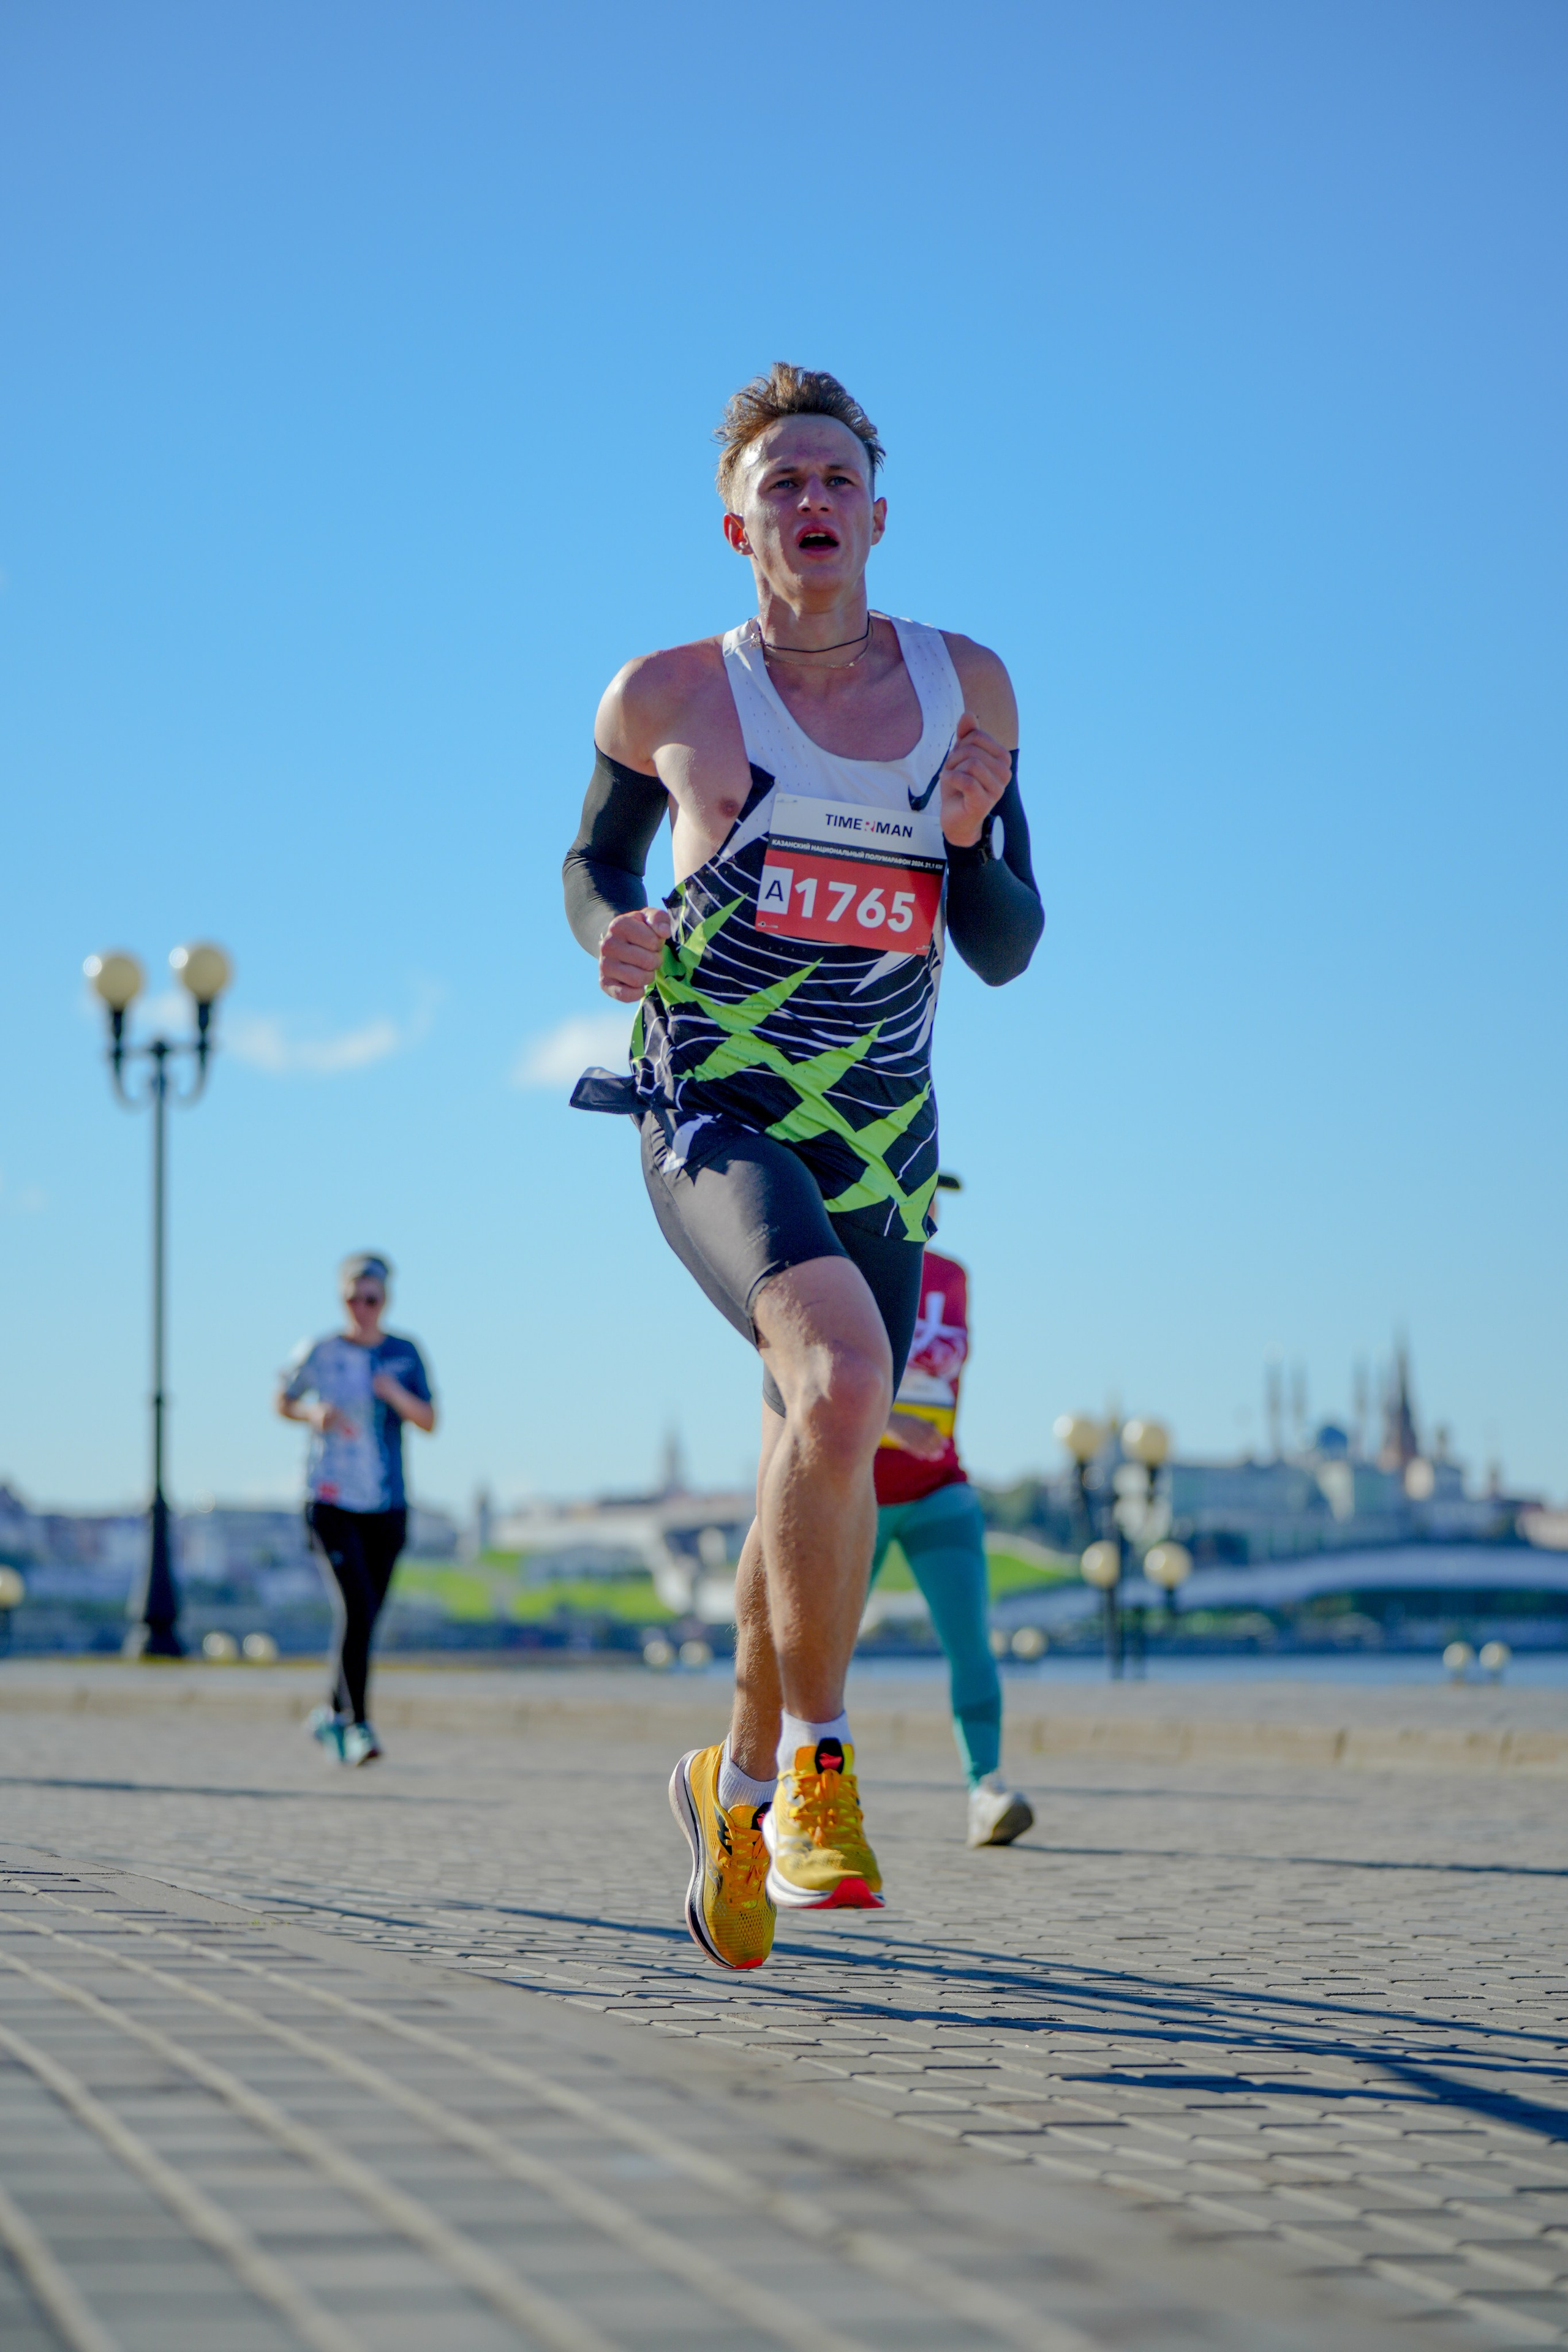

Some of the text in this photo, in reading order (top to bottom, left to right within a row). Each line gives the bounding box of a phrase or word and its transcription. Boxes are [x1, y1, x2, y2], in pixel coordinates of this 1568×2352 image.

[772, 839, 810, 850] КАЗАНСКИЙ
[810, 844, 864, 859] НАЦИОНАЛЬНЫЙ
[865, 853, 911, 865] ПОЛУМАРАФОН
[795, 878, 915, 932] 1765
